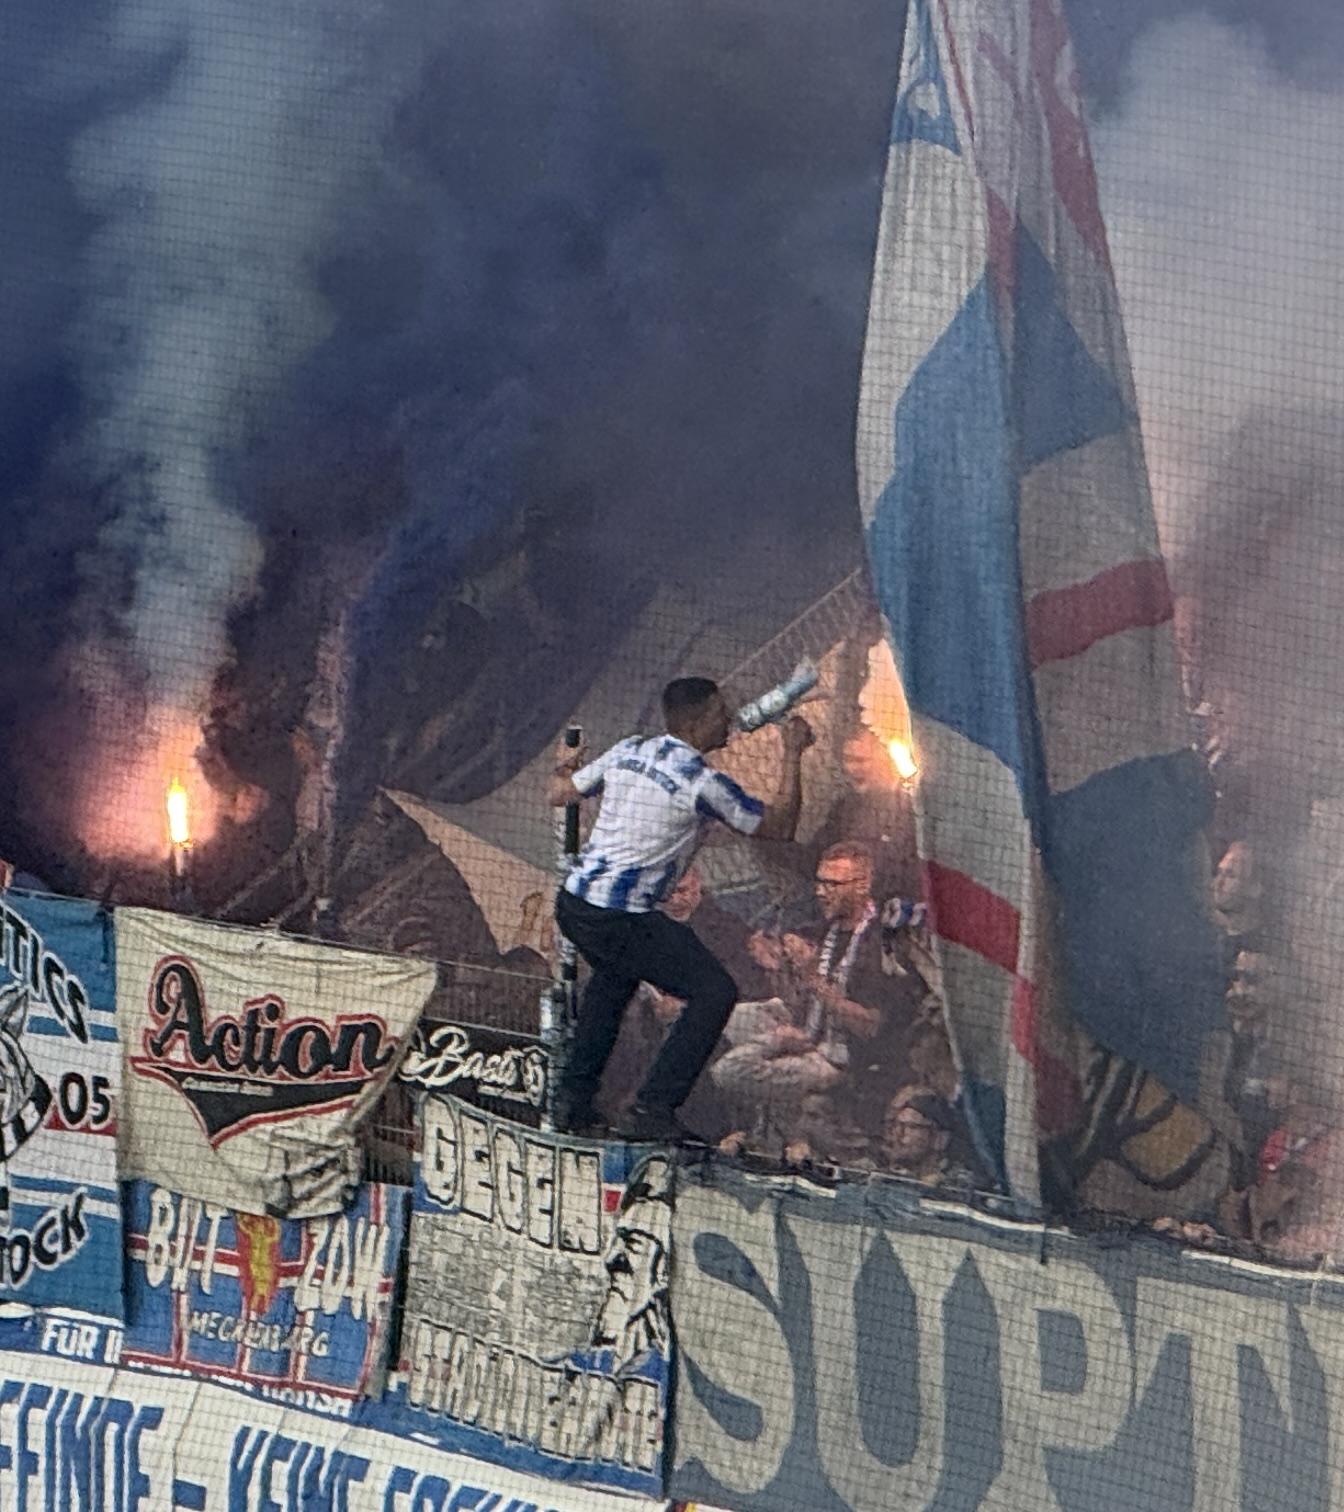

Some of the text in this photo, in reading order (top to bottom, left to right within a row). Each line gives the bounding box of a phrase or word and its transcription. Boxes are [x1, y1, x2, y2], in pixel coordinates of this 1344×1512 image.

[0, 900, 90, 1047] TICS
[145, 958, 398, 1080] Action
[418, 1091, 601, 1254] GEGEN
